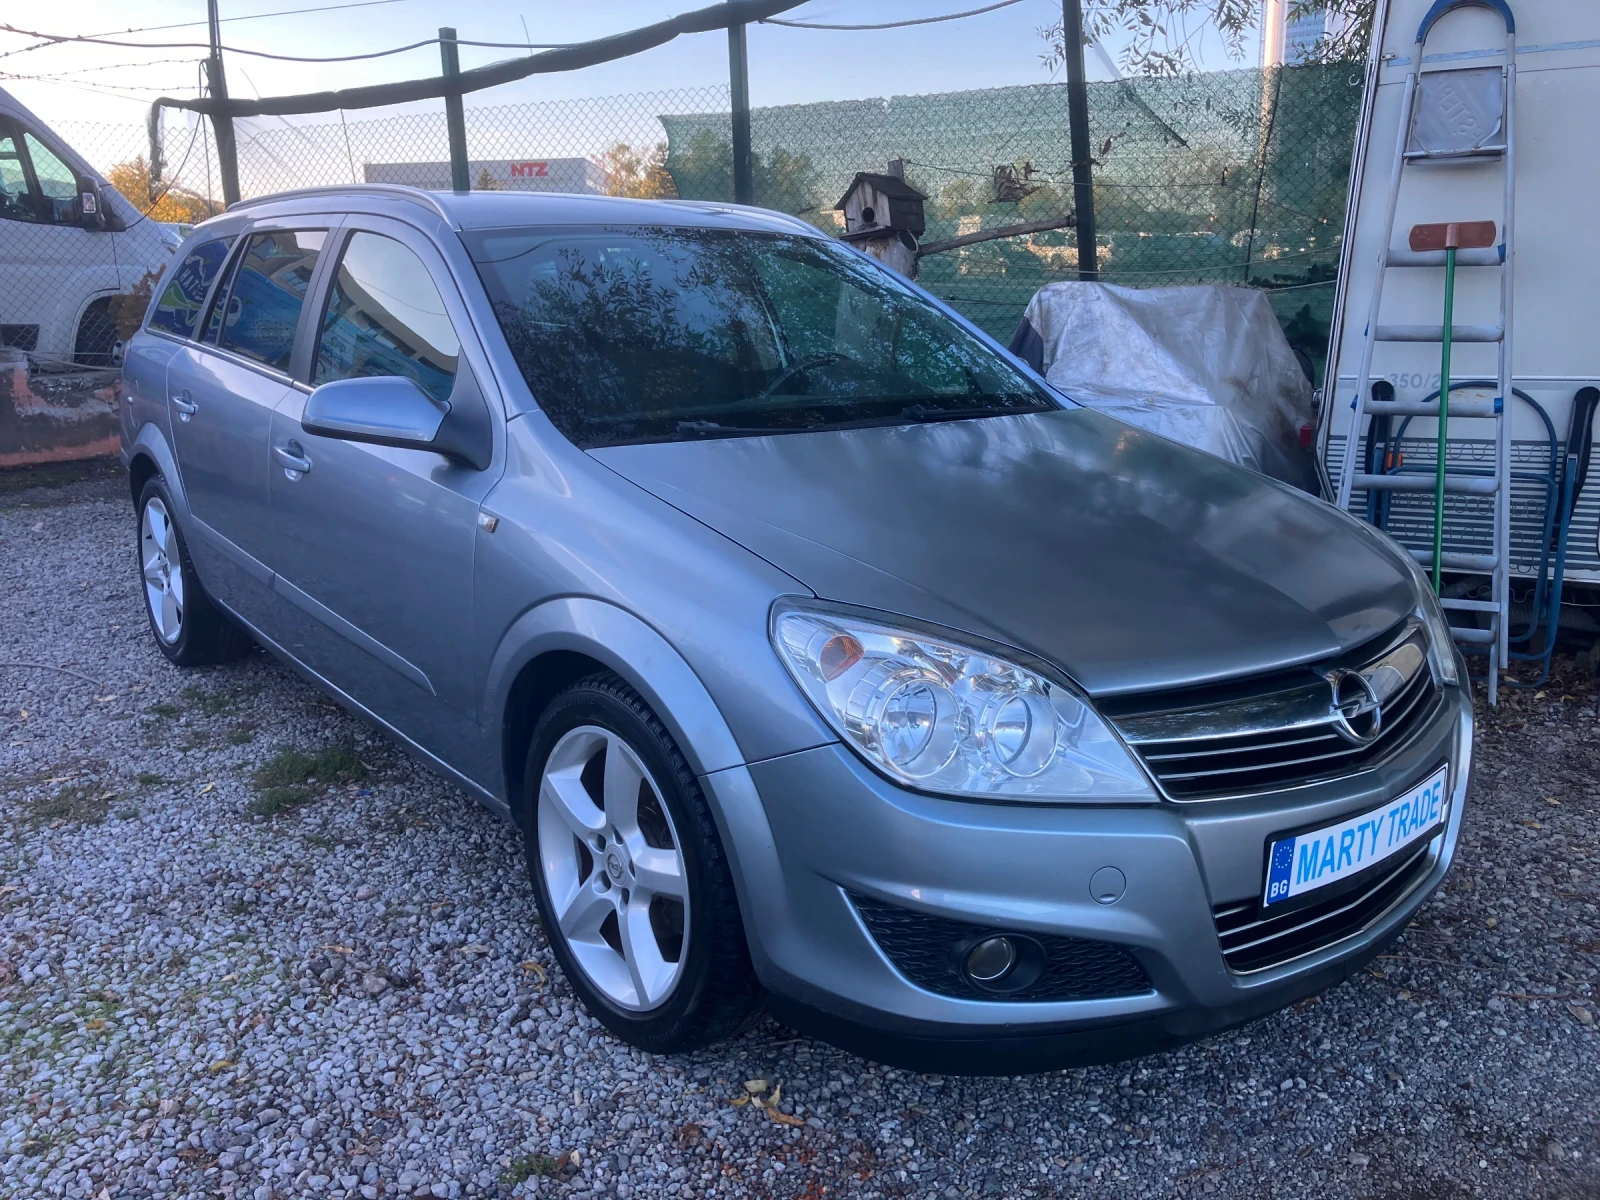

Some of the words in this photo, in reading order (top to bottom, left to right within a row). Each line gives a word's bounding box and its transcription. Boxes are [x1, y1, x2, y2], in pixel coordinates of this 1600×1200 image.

[511, 162, 548, 177] NTZ
[1296, 815, 1384, 886] MARTY
[1388, 780, 1441, 847] TRADE
[1270, 879, 1288, 898] BG
